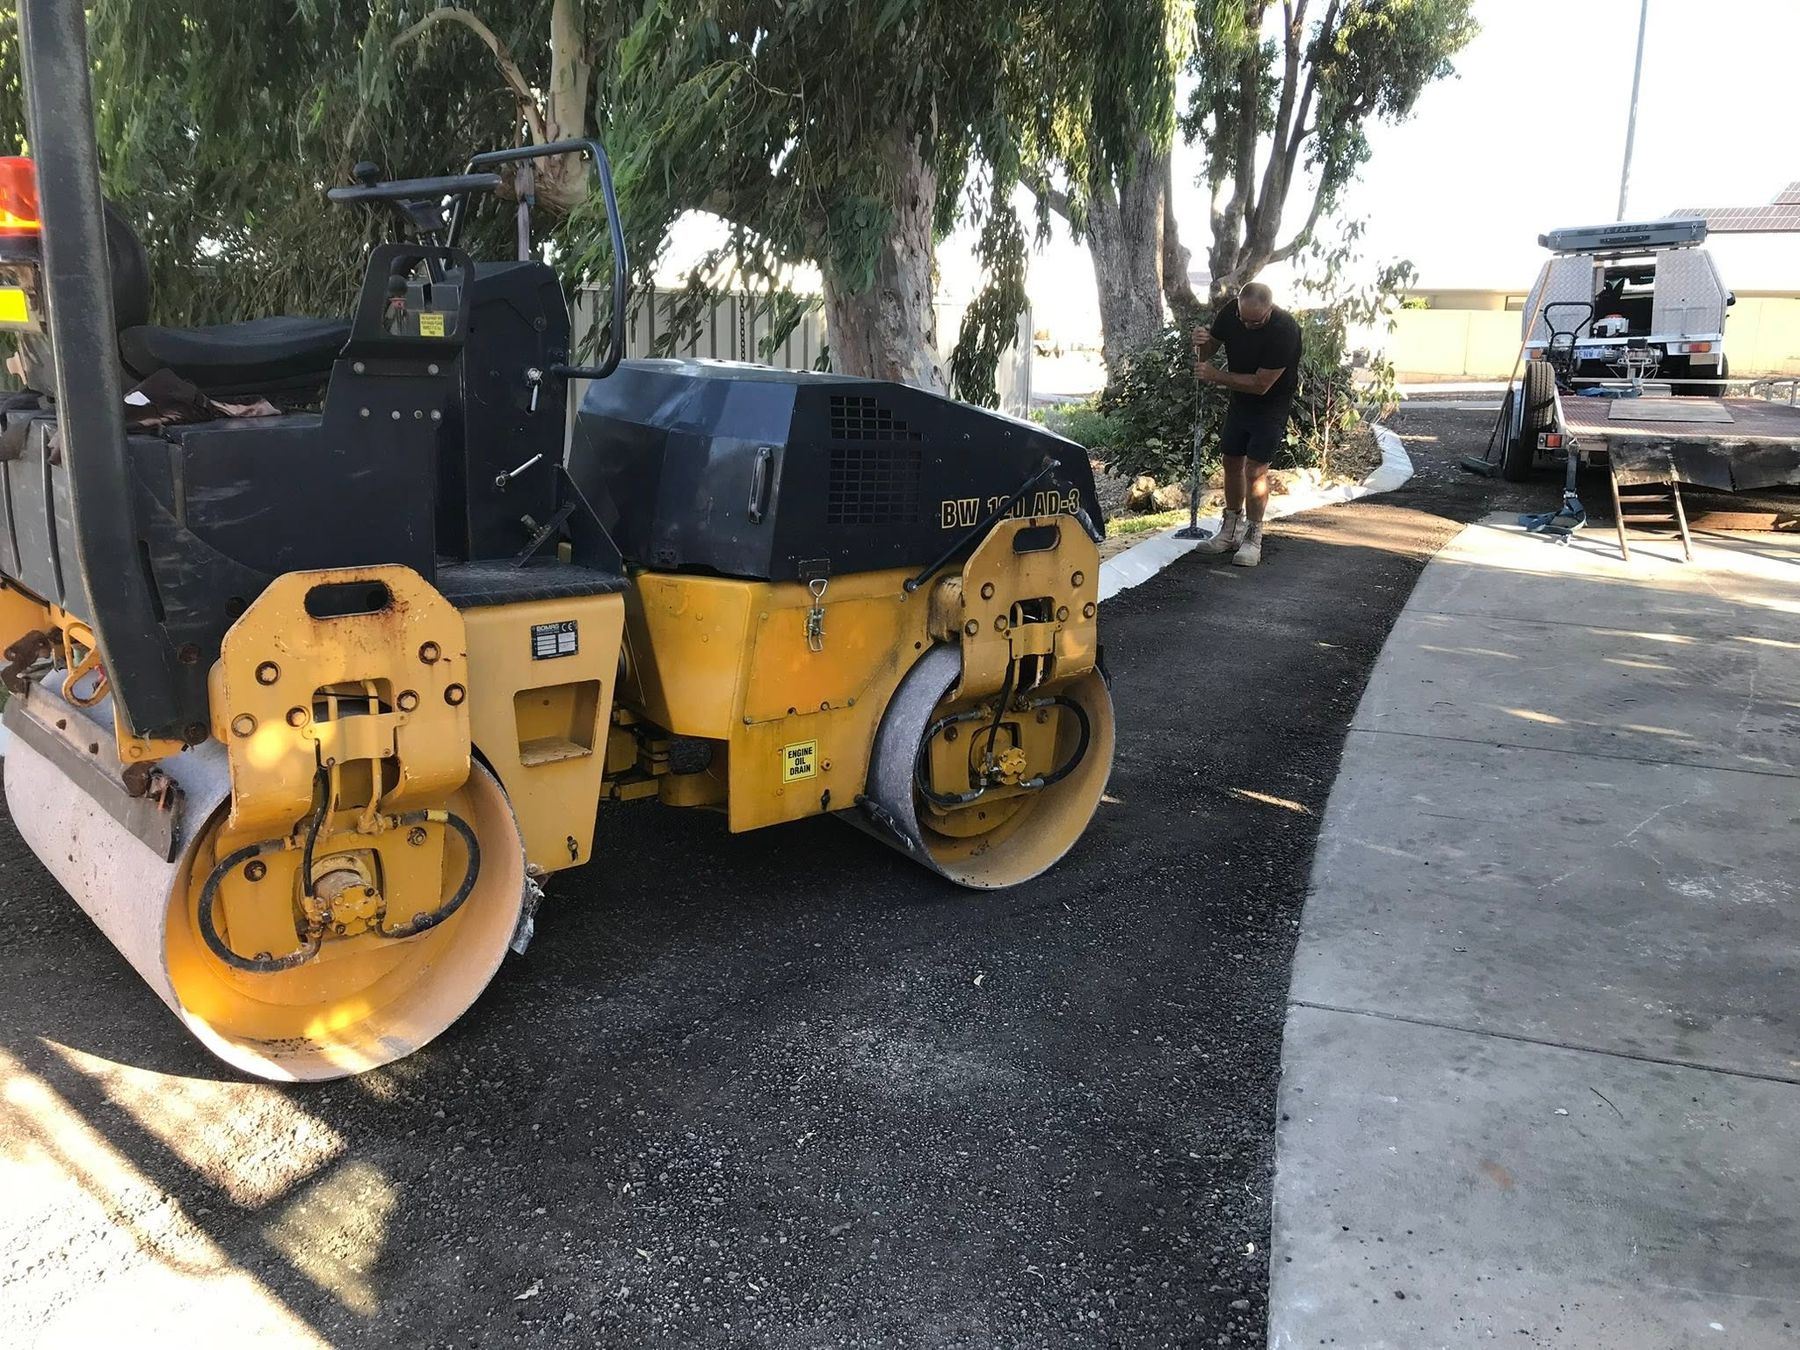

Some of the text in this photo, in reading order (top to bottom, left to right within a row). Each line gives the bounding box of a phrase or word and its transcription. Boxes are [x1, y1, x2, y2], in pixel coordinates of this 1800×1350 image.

[942, 498, 979, 528] BW
[1032, 488, 1080, 516] AD-3
[561, 622, 573, 632] CE
[788, 747, 812, 759] ENGINE
[795, 757, 806, 766] OIL
[790, 764, 811, 775] DRAIN
